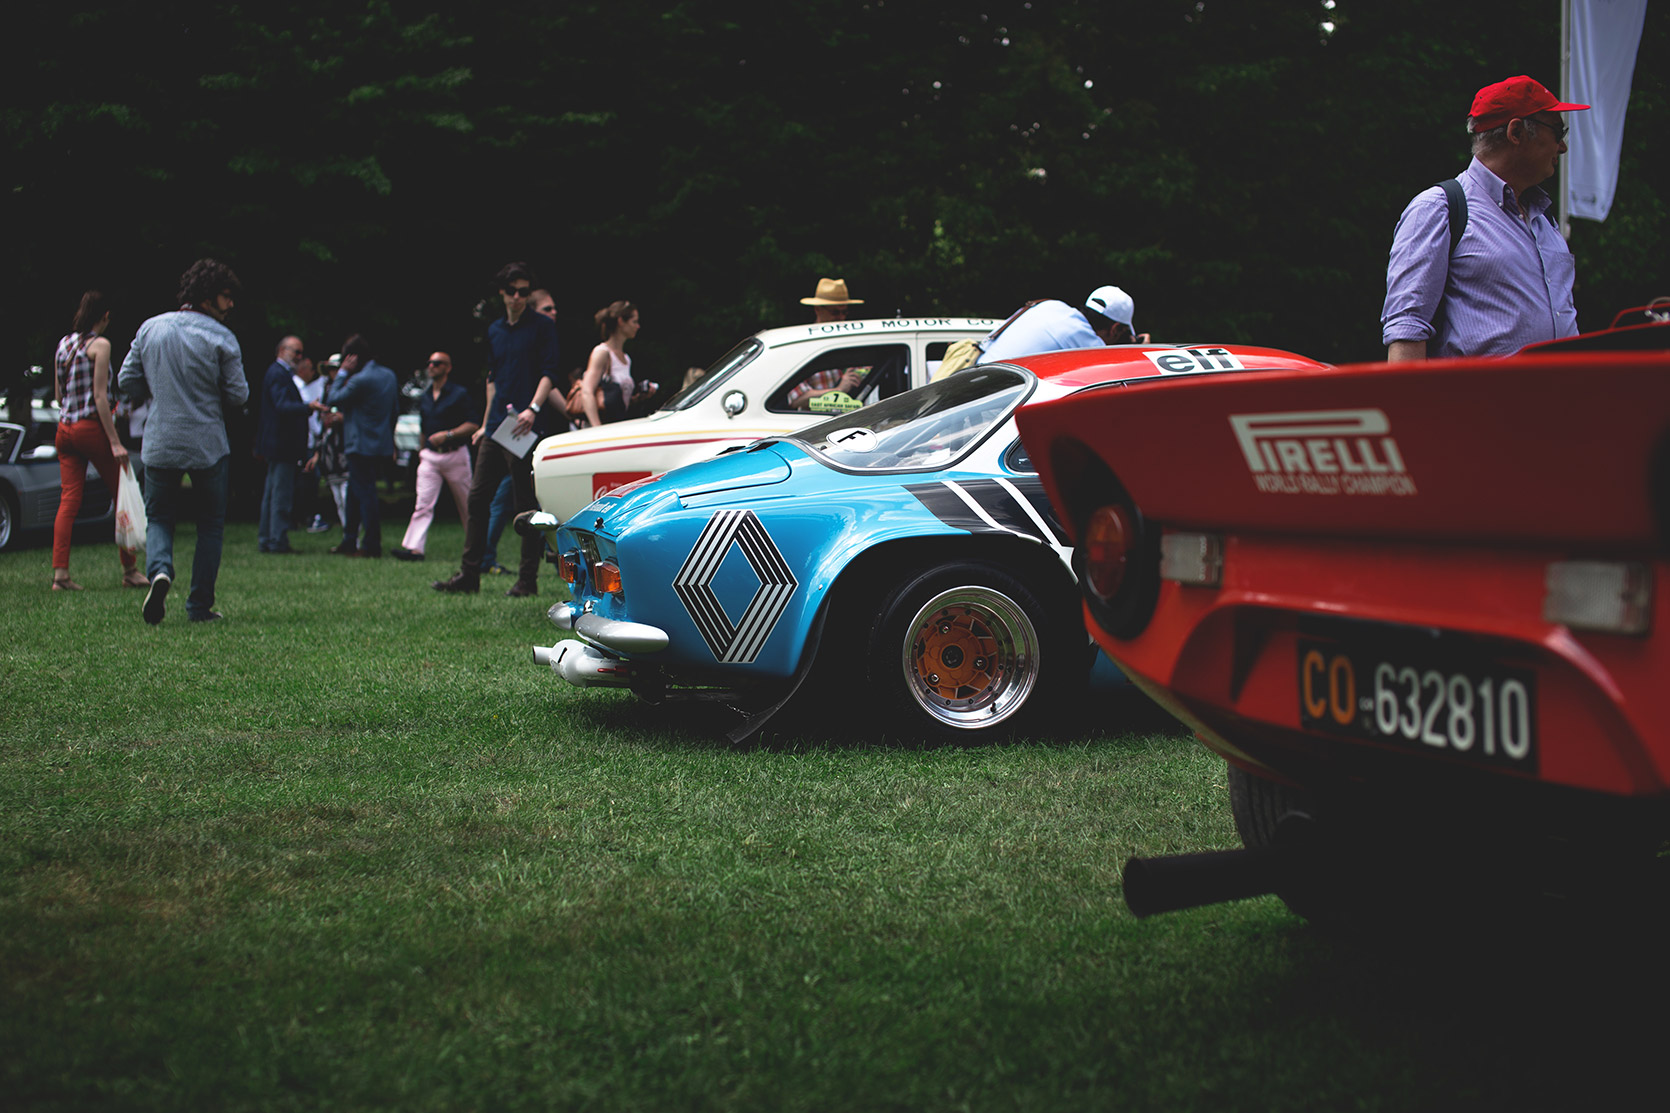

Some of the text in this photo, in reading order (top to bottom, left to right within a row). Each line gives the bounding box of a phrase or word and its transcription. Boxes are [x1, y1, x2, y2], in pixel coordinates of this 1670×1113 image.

[808, 319, 864, 335] FORD
[881, 318, 951, 329] MOTOR
[1156, 348, 1234, 373] elf
[833, 393, 840, 403] 7
[836, 430, 867, 443] F
[1228, 407, 1407, 473] PIRELLI
[1254, 473, 1418, 496] WORLD RALLY CHAMPION
[1303, 650, 1530, 760] CO 632810
